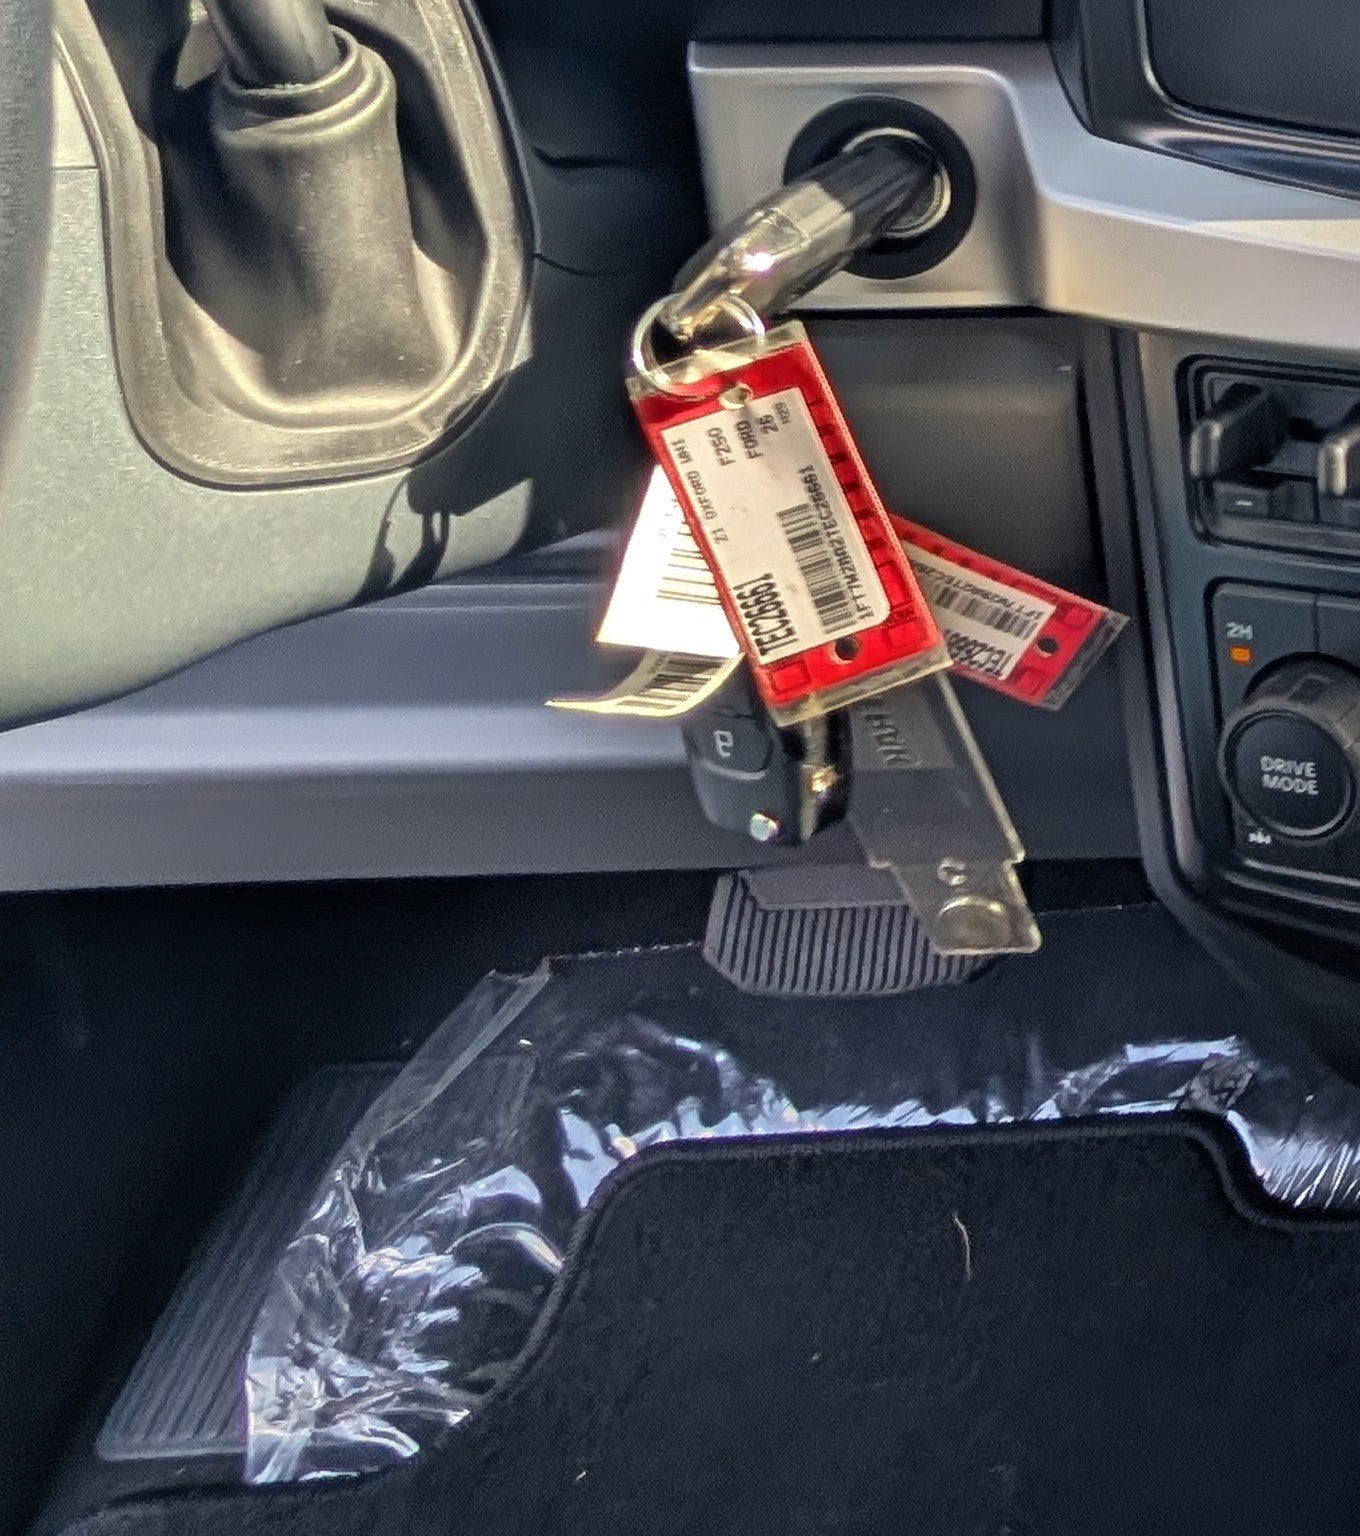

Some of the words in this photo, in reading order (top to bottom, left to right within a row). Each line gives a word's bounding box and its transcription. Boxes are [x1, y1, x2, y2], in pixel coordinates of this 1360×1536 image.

[707, 426, 736, 468] F250
[734, 420, 764, 461] FORD
[732, 572, 800, 657] TEC26661
[1259, 755, 1318, 778] DRIVE
[1261, 773, 1320, 796] MODE
